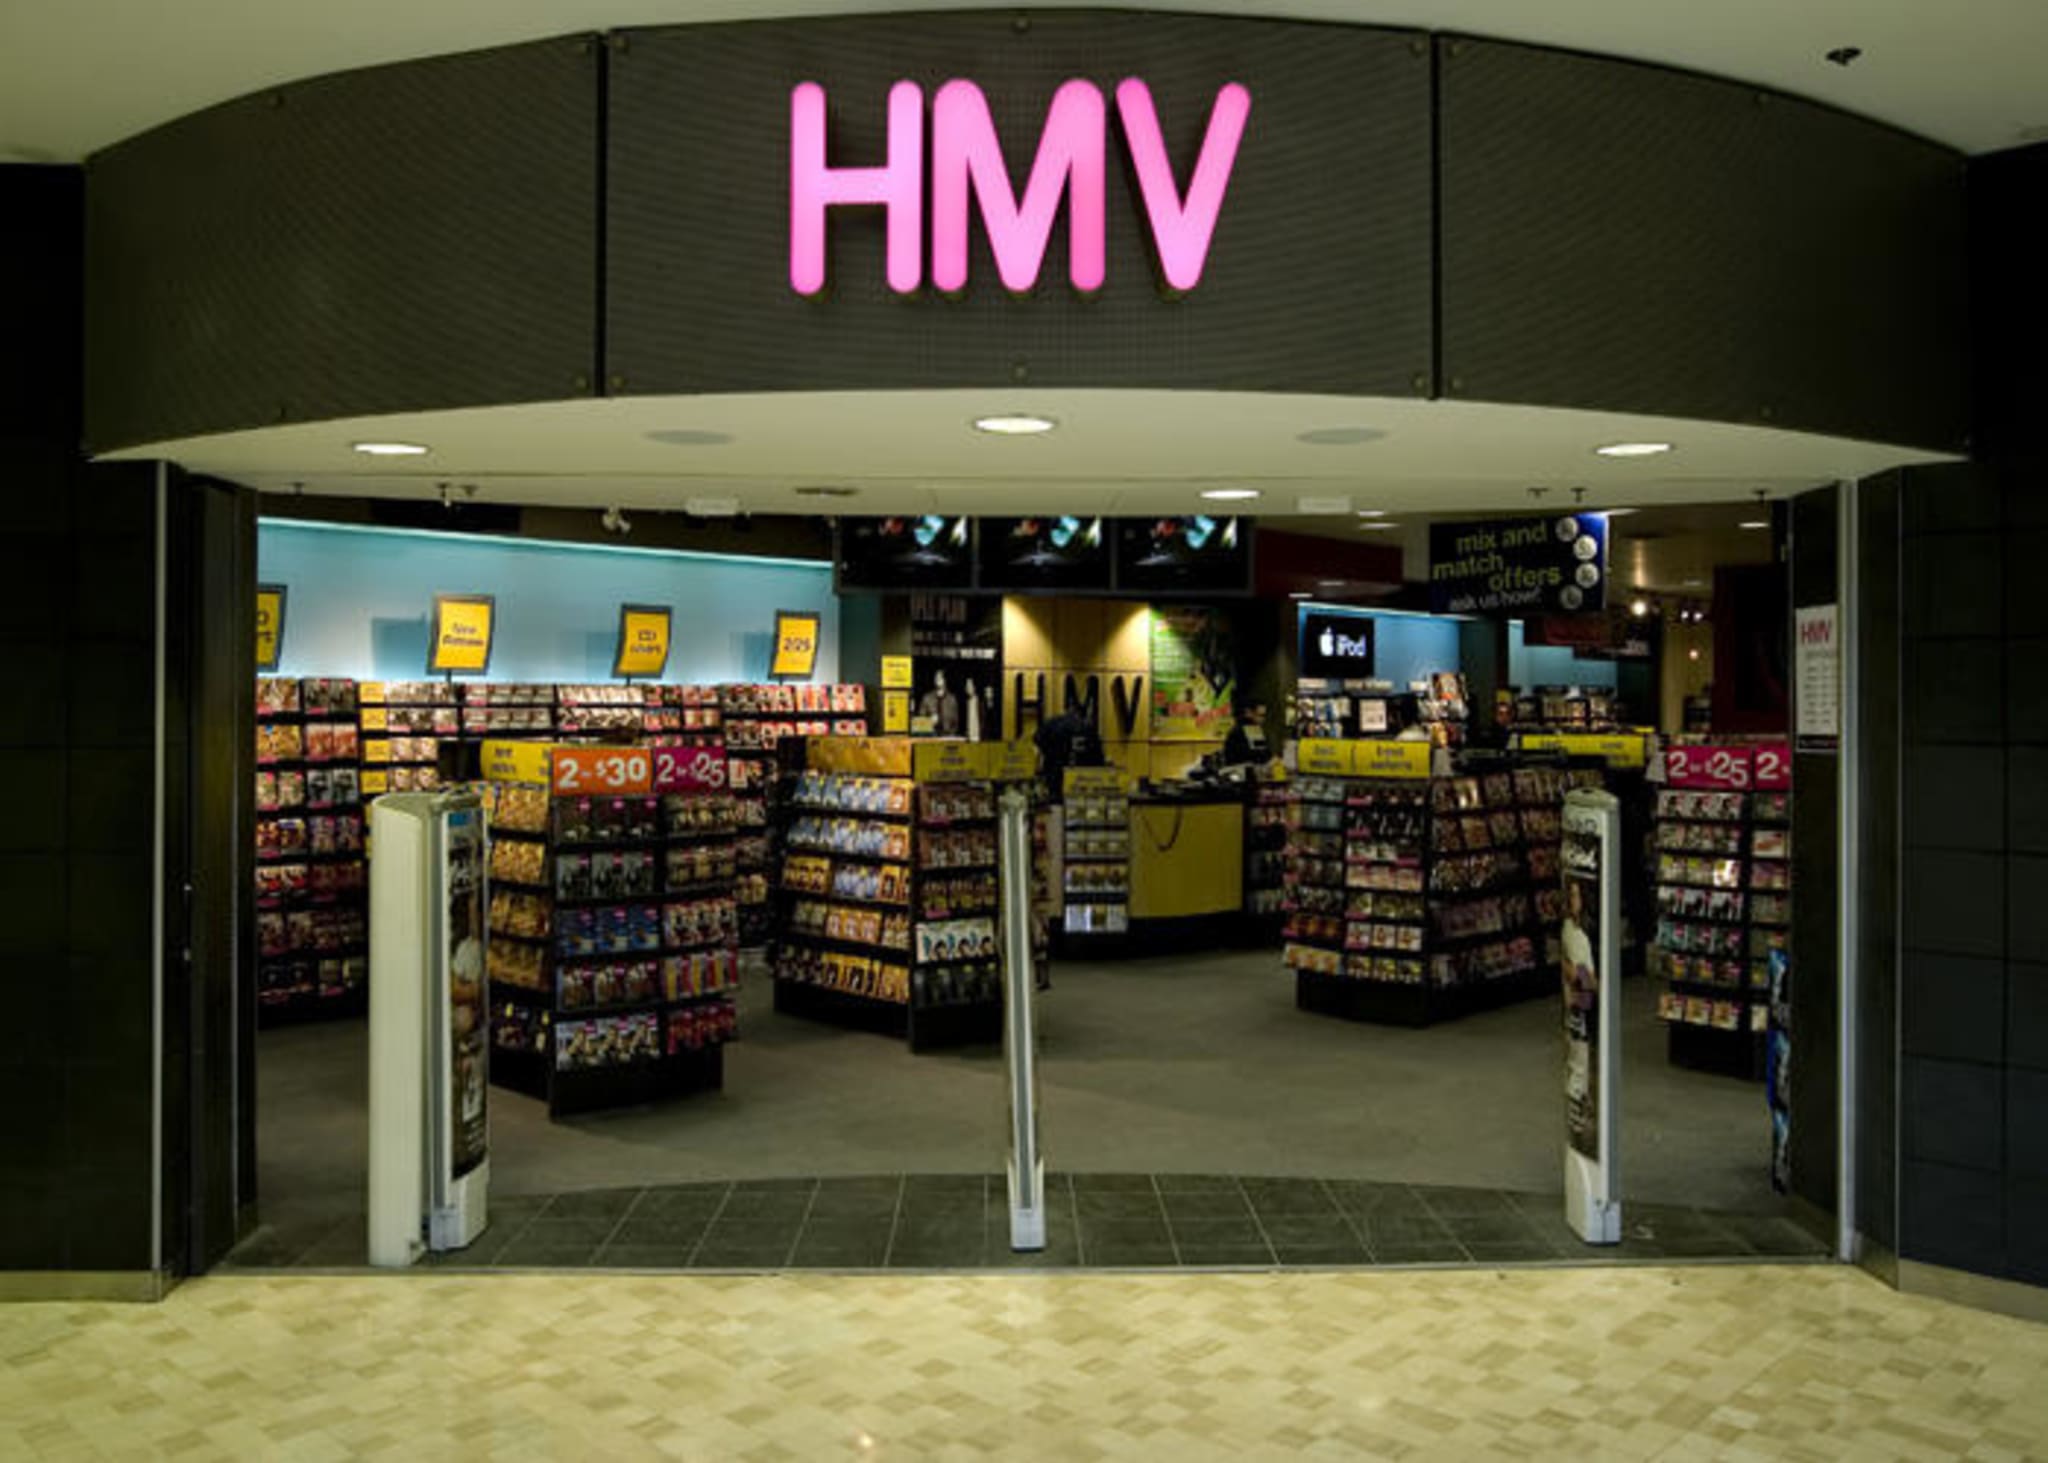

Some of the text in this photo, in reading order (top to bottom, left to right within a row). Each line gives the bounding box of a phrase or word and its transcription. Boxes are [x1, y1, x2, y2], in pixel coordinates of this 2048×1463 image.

[791, 77, 1251, 294] HMV
[1455, 521, 1548, 554] mix and
[1432, 552, 1504, 580] match
[1488, 566, 1562, 592] offers
[1015, 672, 1143, 743] HMV
[558, 757, 580, 789] 2
[594, 756, 648, 787] $30
[657, 753, 675, 783] 2
[1668, 750, 1689, 779] 2
[1756, 751, 1780, 780] 2
